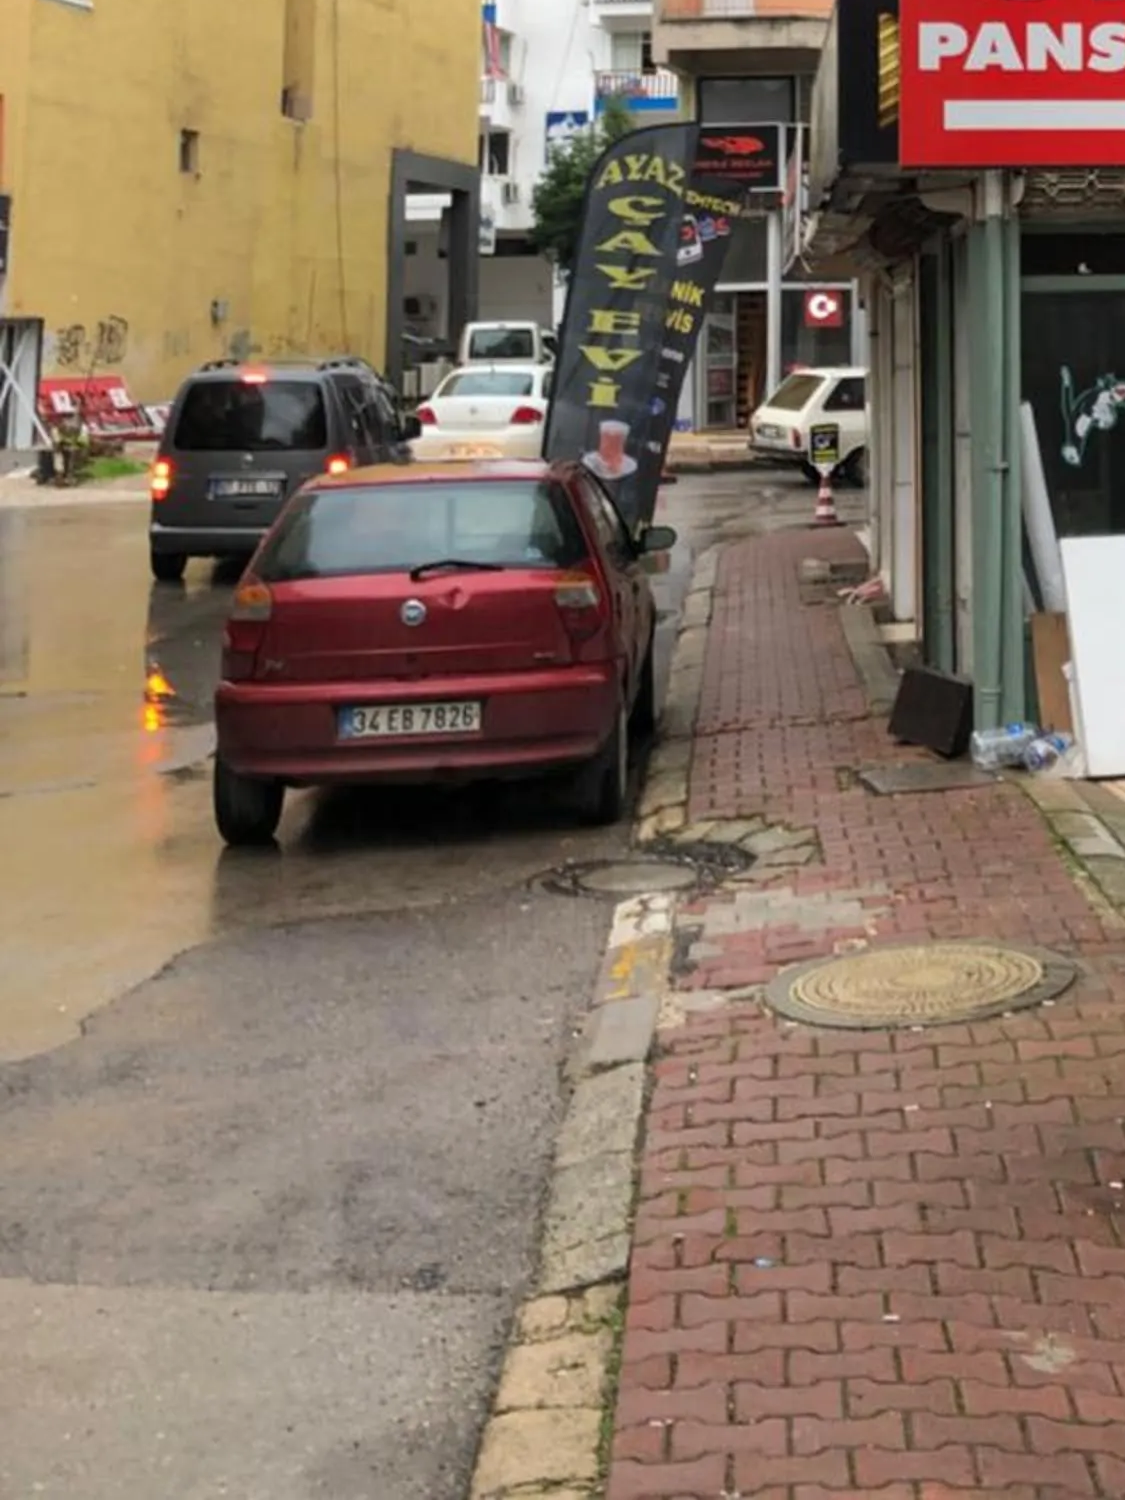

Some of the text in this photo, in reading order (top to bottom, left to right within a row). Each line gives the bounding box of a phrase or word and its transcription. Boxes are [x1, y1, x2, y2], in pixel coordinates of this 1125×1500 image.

[594, 153, 686, 198] AYAZ
[352, 704, 474, 733] 34 EB 7826
